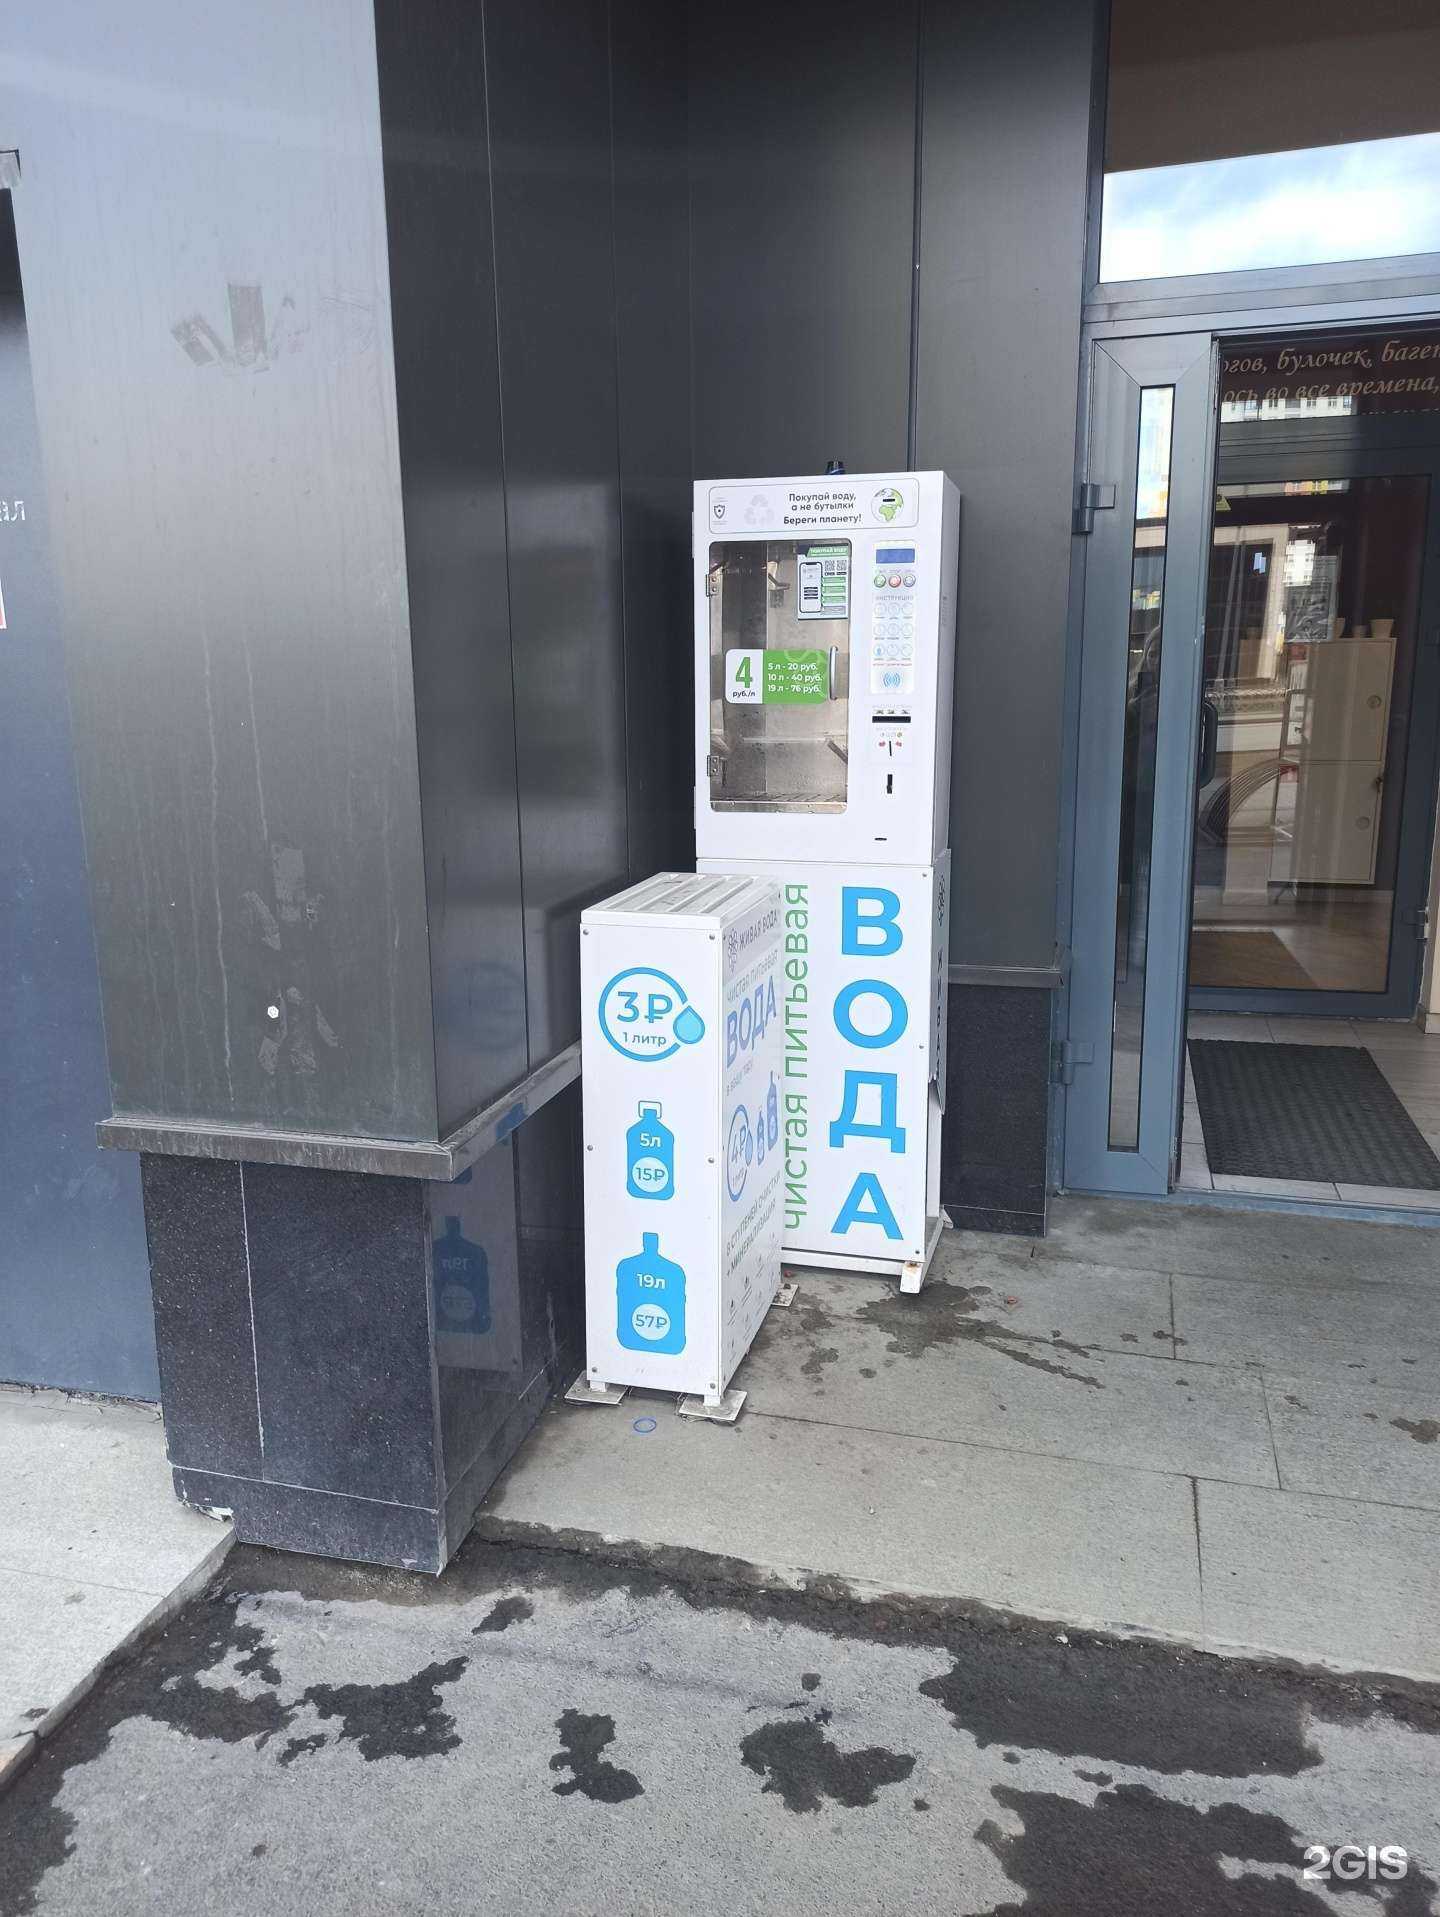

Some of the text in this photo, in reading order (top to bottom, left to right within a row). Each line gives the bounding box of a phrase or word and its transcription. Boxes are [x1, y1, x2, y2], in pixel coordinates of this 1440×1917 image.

[1277, 347, 1374, 376] булочек,
[1335, 374, 1440, 398] времена,
[788, 492, 857, 502] Покупай воду,
[800, 503, 811, 511] не
[814, 501, 854, 511] бутылки
[783, 513, 862, 525] Береги планету!
[735, 656, 753, 689] 4
[800, 663, 818, 672] руб.
[804, 673, 823, 682] руб.
[732, 689, 756, 698] руб./л
[768, 684, 777, 692] 19
[790, 684, 801, 692] 76
[803, 684, 821, 694] руб.
[738, 908, 778, 951] ЖИВАЯ ВОДА
[726, 974, 777, 1070] ВОДА
[623, 1031, 667, 1047] 1 литр
[829, 886, 909, 1241] ВОДА
[639, 1132, 661, 1148] 5л
[637, 1273, 667, 1290] 19л
